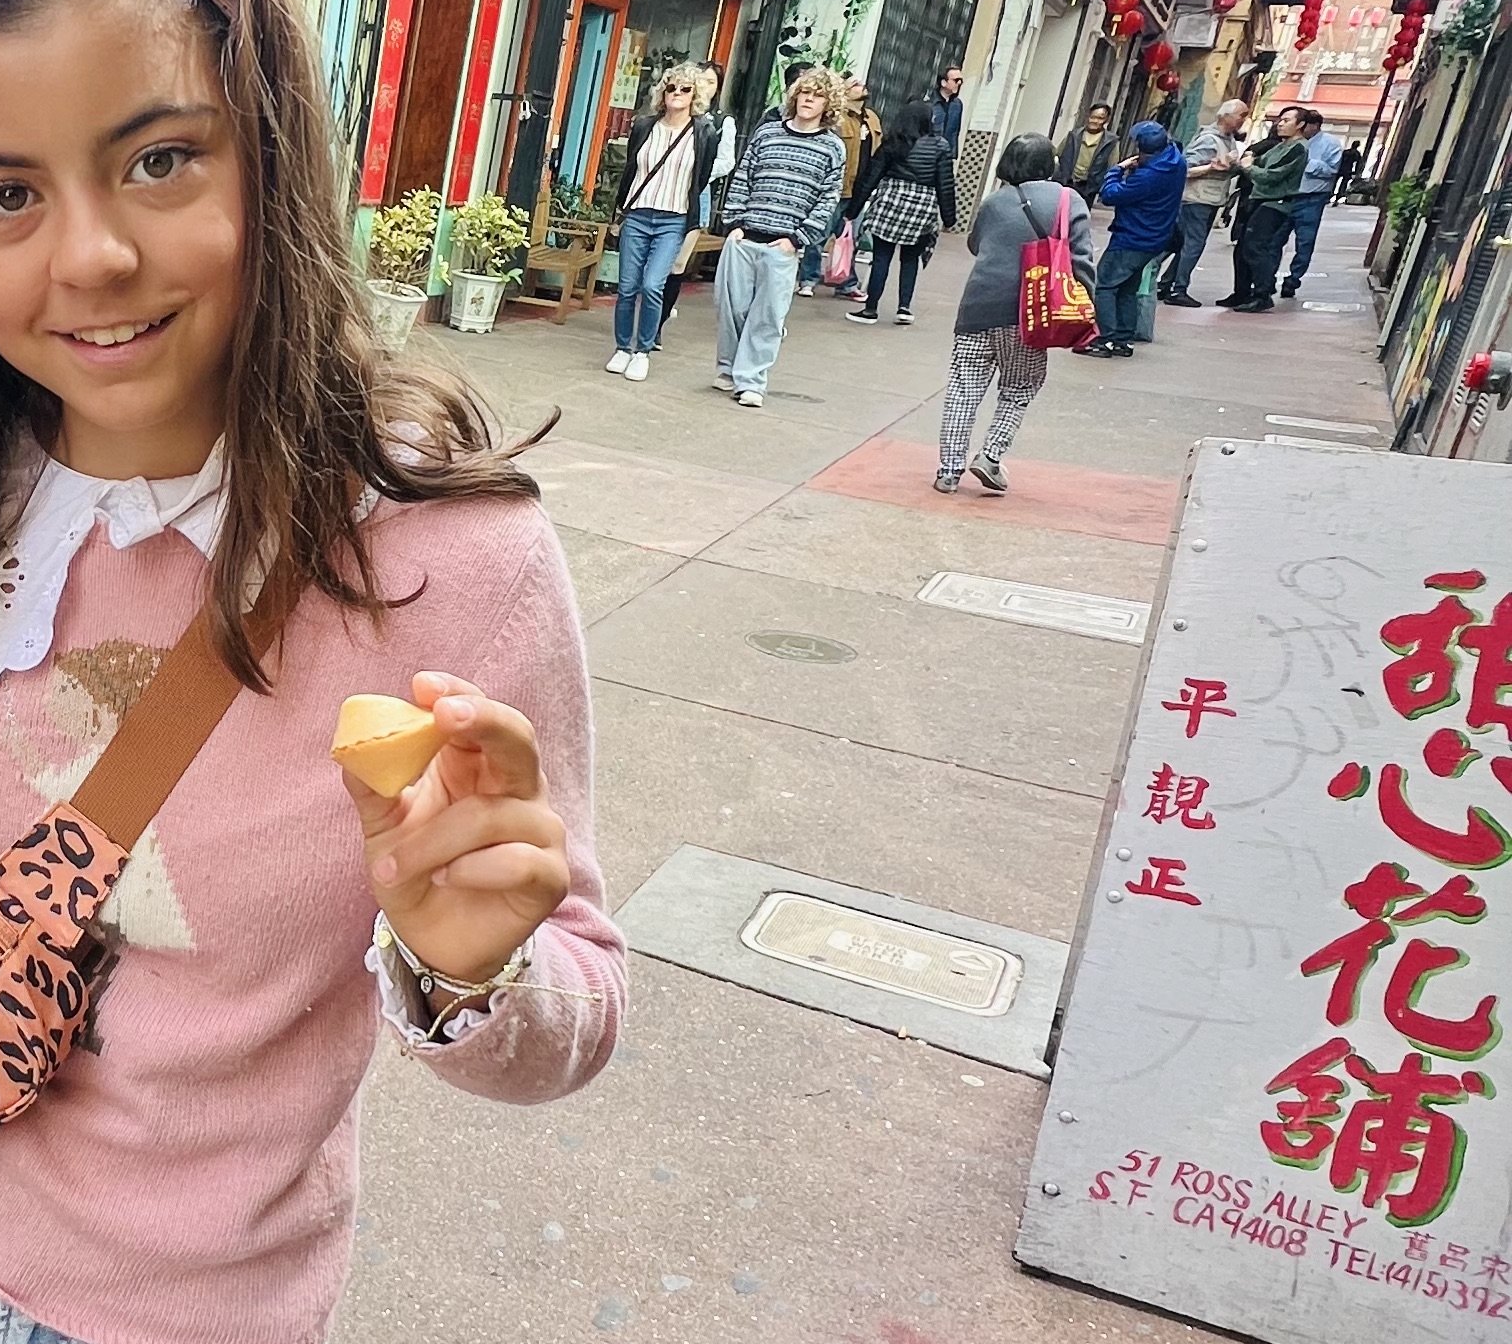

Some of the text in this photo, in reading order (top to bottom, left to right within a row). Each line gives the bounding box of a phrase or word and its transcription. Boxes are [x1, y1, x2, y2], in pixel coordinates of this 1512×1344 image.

[1126, 676, 1237, 907] 平靚正
[1118, 1149, 1368, 1238] 51 ROSS ALLEY
